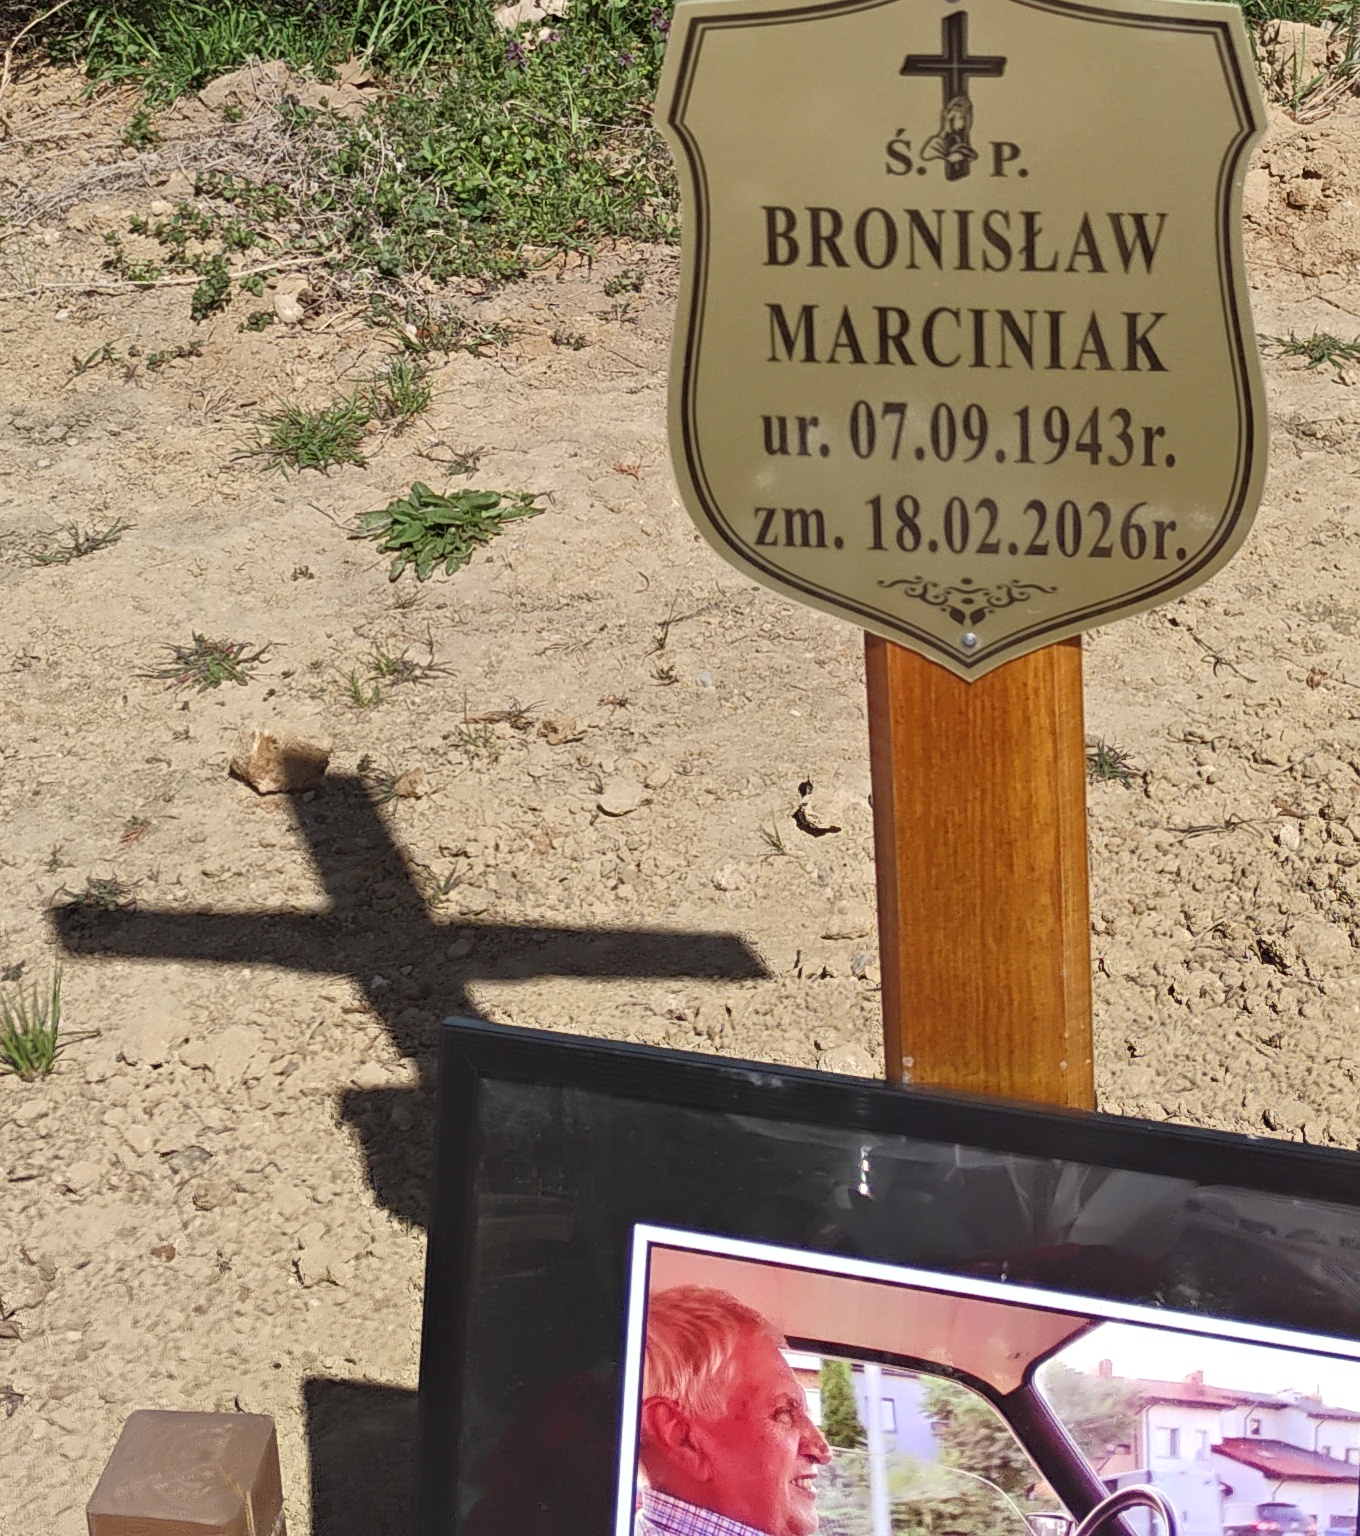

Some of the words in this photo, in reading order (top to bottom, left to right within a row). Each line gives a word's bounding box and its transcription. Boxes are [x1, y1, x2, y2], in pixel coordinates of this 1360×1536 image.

[886, 128, 927, 176] Ś.
[989, 141, 1029, 178] P.
[761, 205, 1169, 275] BRONISŁAW
[765, 302, 1169, 372] MARCINIAK
[760, 413, 831, 457] ur.
[848, 400, 1177, 468] 07.09.1943r.
[754, 505, 844, 550] zm.
[865, 494, 1187, 561] 18.02.2026r.
